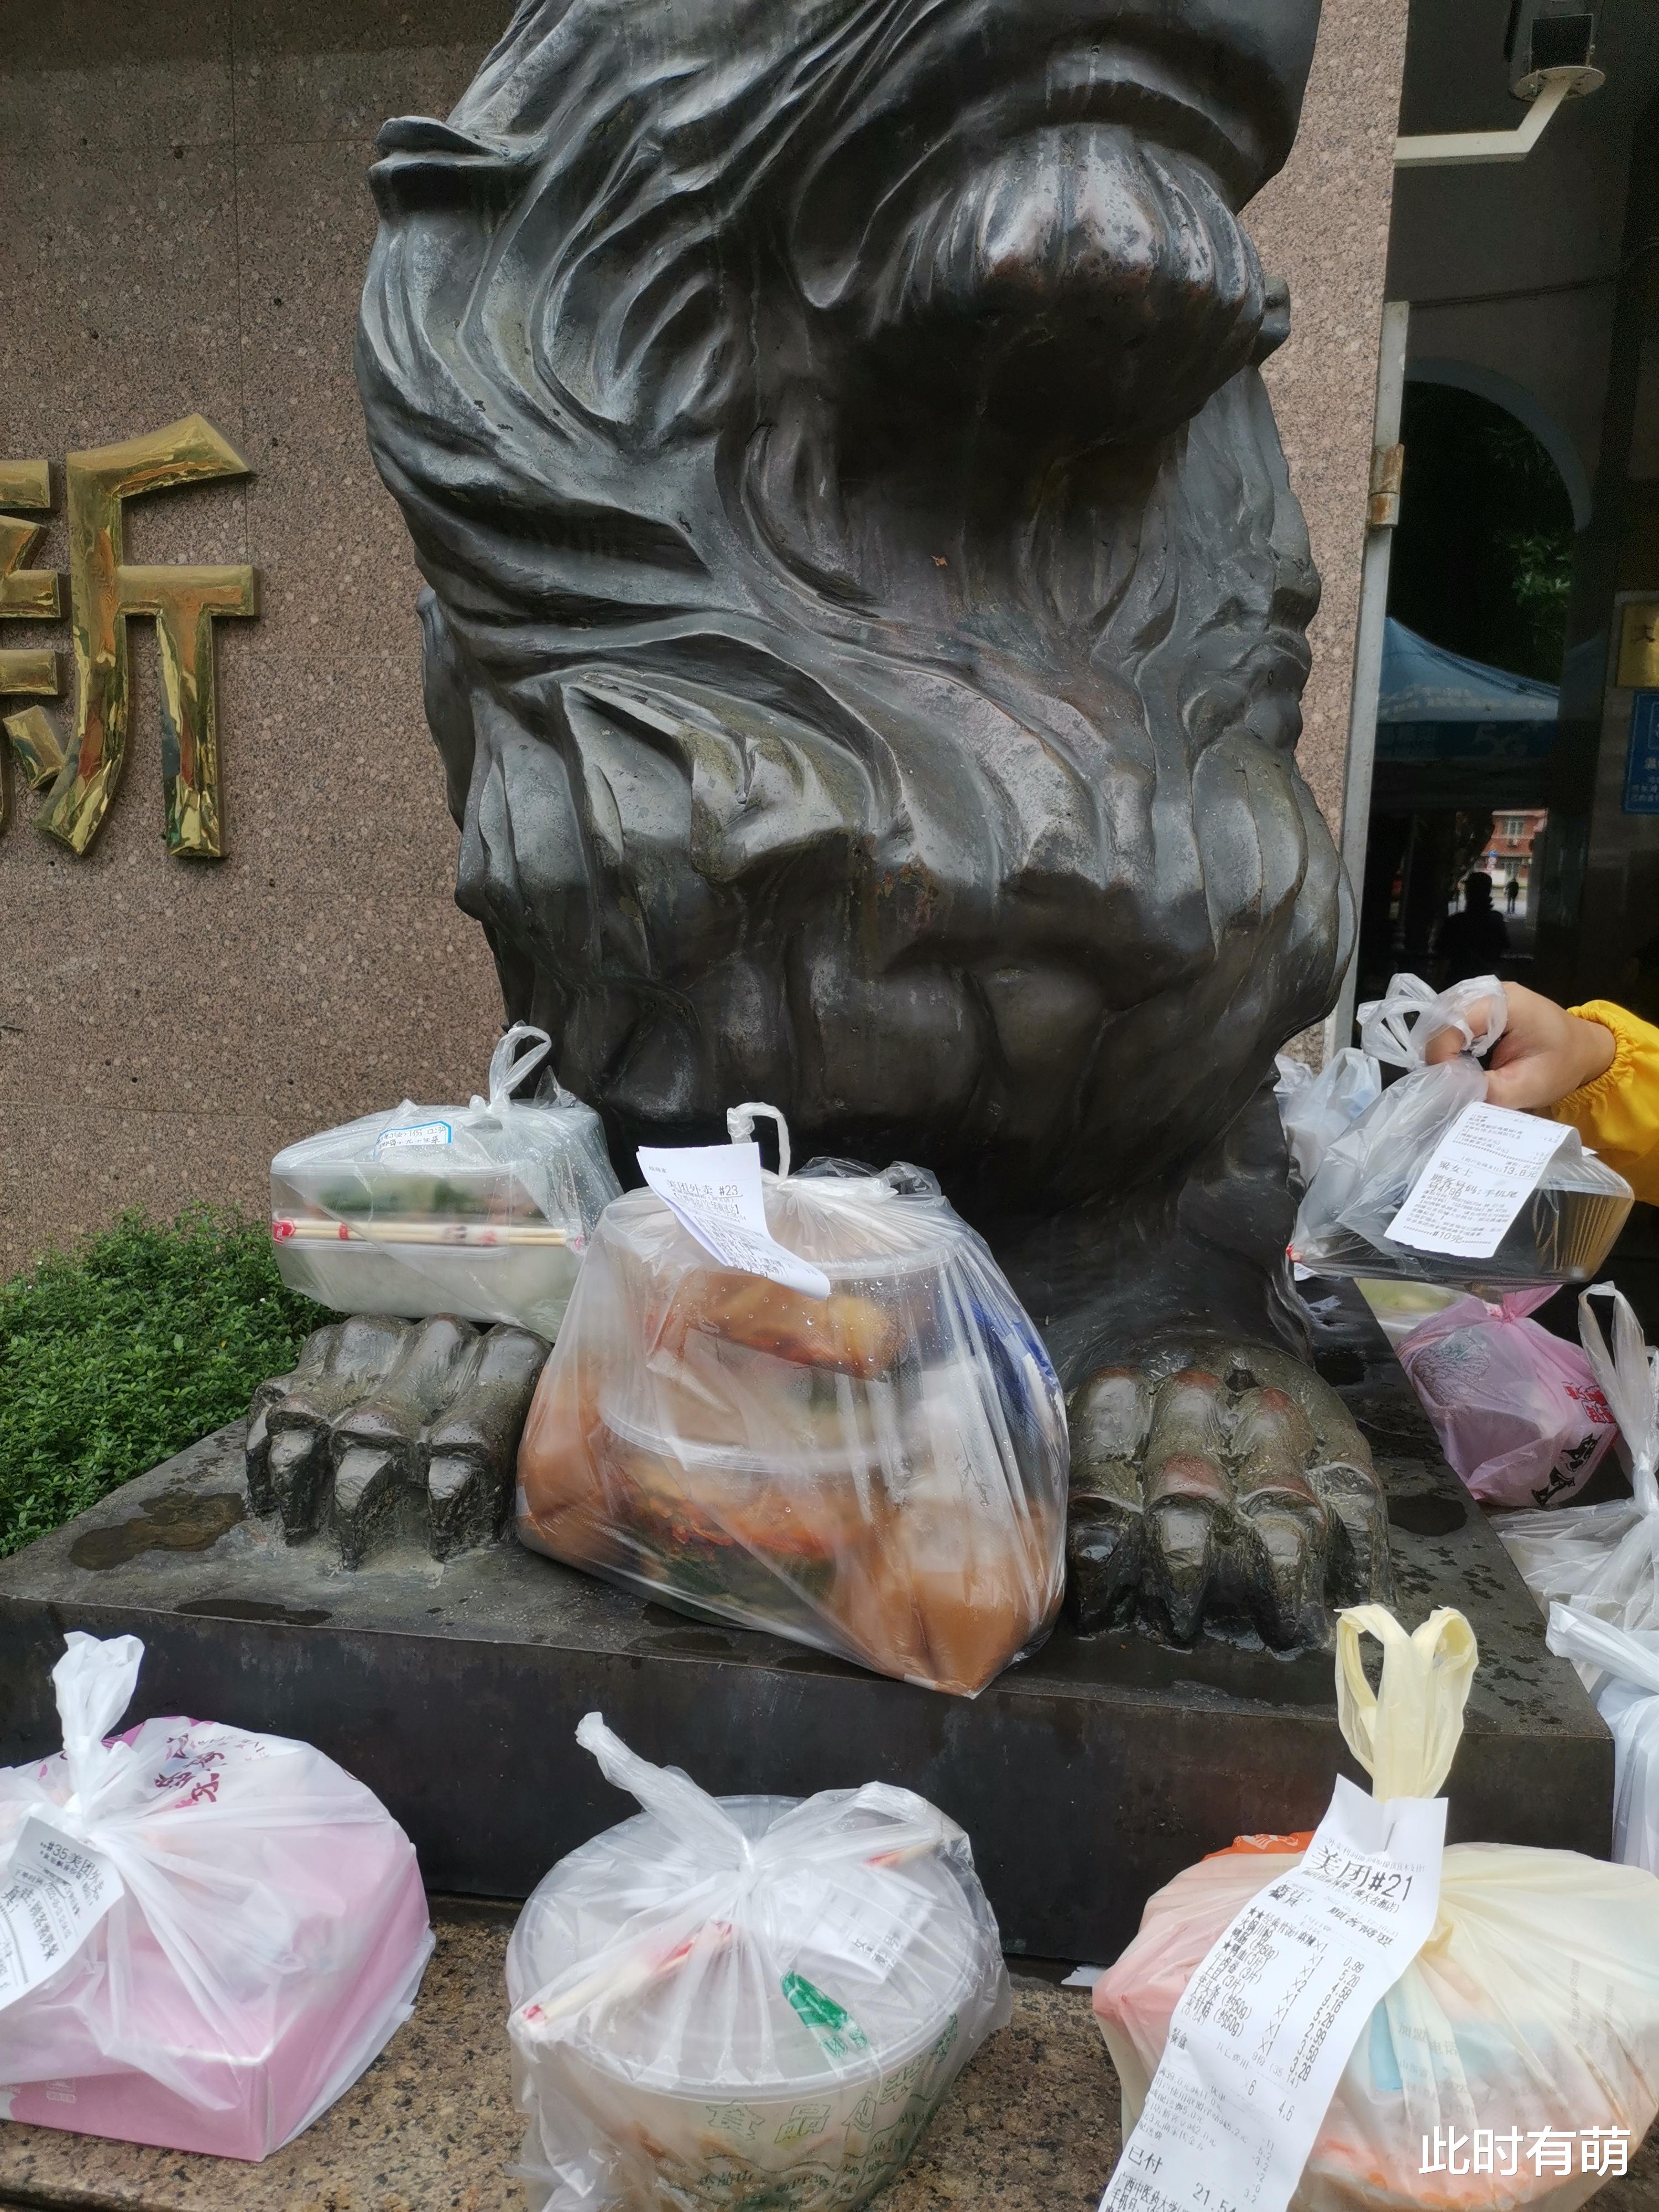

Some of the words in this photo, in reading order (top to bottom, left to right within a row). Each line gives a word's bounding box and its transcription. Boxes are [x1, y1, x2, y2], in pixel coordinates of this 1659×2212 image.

[719, 1184, 738, 1196] #23
[1305, 1844, 1413, 1902] 美团#21
[1343, 1956, 1365, 1974] 0.99
[1331, 1981, 1353, 2001] 4.58
[1321, 1994, 1344, 2014] 9.16
[1313, 2007, 1335, 2030] 5.28
[1304, 2022, 1327, 2047] 2.99
[1290, 2056, 1312, 2082] 3.28
[1278, 2099, 1295, 2122] 4.6
[1128, 2146, 1164, 2175] 已付
